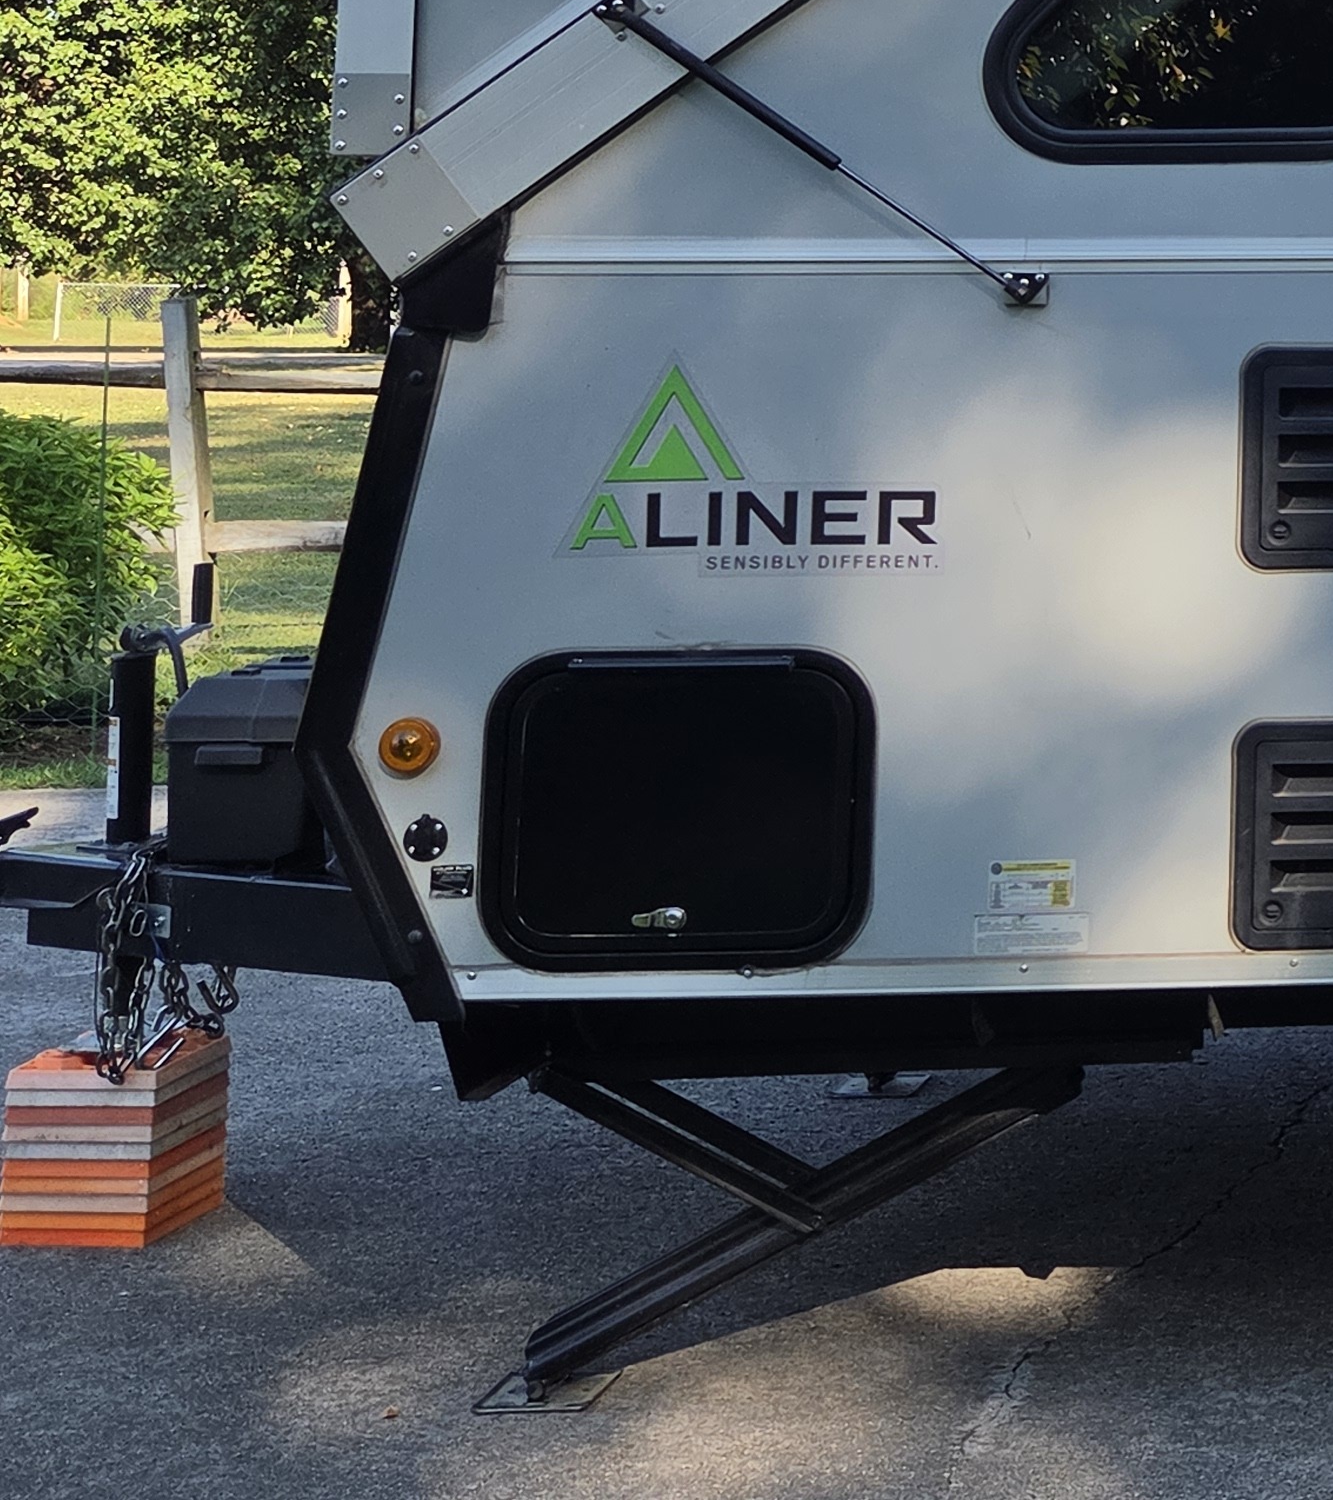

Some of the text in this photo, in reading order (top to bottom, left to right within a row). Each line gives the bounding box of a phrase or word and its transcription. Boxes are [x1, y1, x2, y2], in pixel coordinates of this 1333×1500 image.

[569, 490, 938, 551] ALINER
[705, 554, 940, 571] SENSIBLY DIFFERENT.
